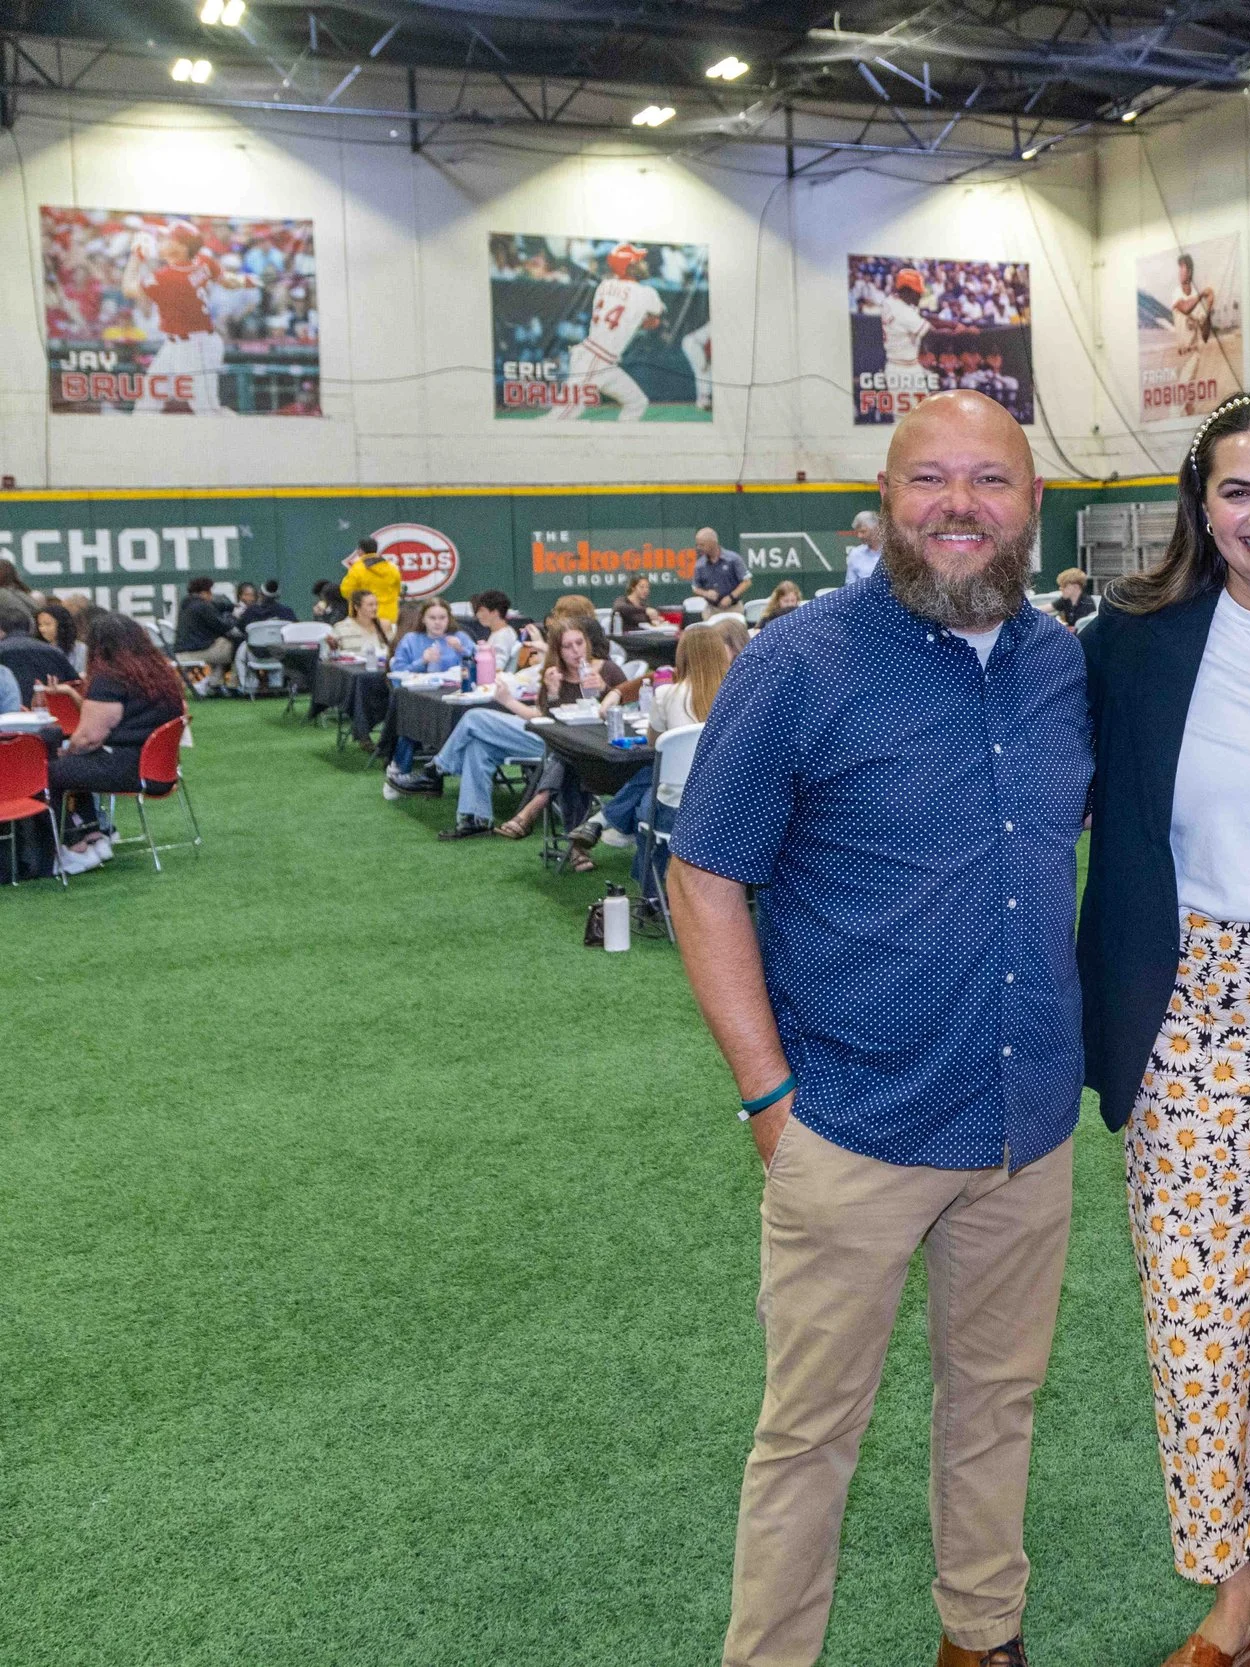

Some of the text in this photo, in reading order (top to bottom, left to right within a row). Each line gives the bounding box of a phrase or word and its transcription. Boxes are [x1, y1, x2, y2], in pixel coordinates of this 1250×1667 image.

[60, 350, 117, 371] JAY
[503, 361, 559, 380] ERIC
[61, 372, 195, 401] BRUCE
[860, 372, 940, 390] GEORGE
[504, 380, 601, 407] DAVIS
[860, 390, 941, 415] FOST
[1143, 378, 1218, 407] ROBINSON
[533, 530, 570, 542] THE
[748, 547, 801, 569] MSA
[563, 572, 678, 587] GROUP NC.
